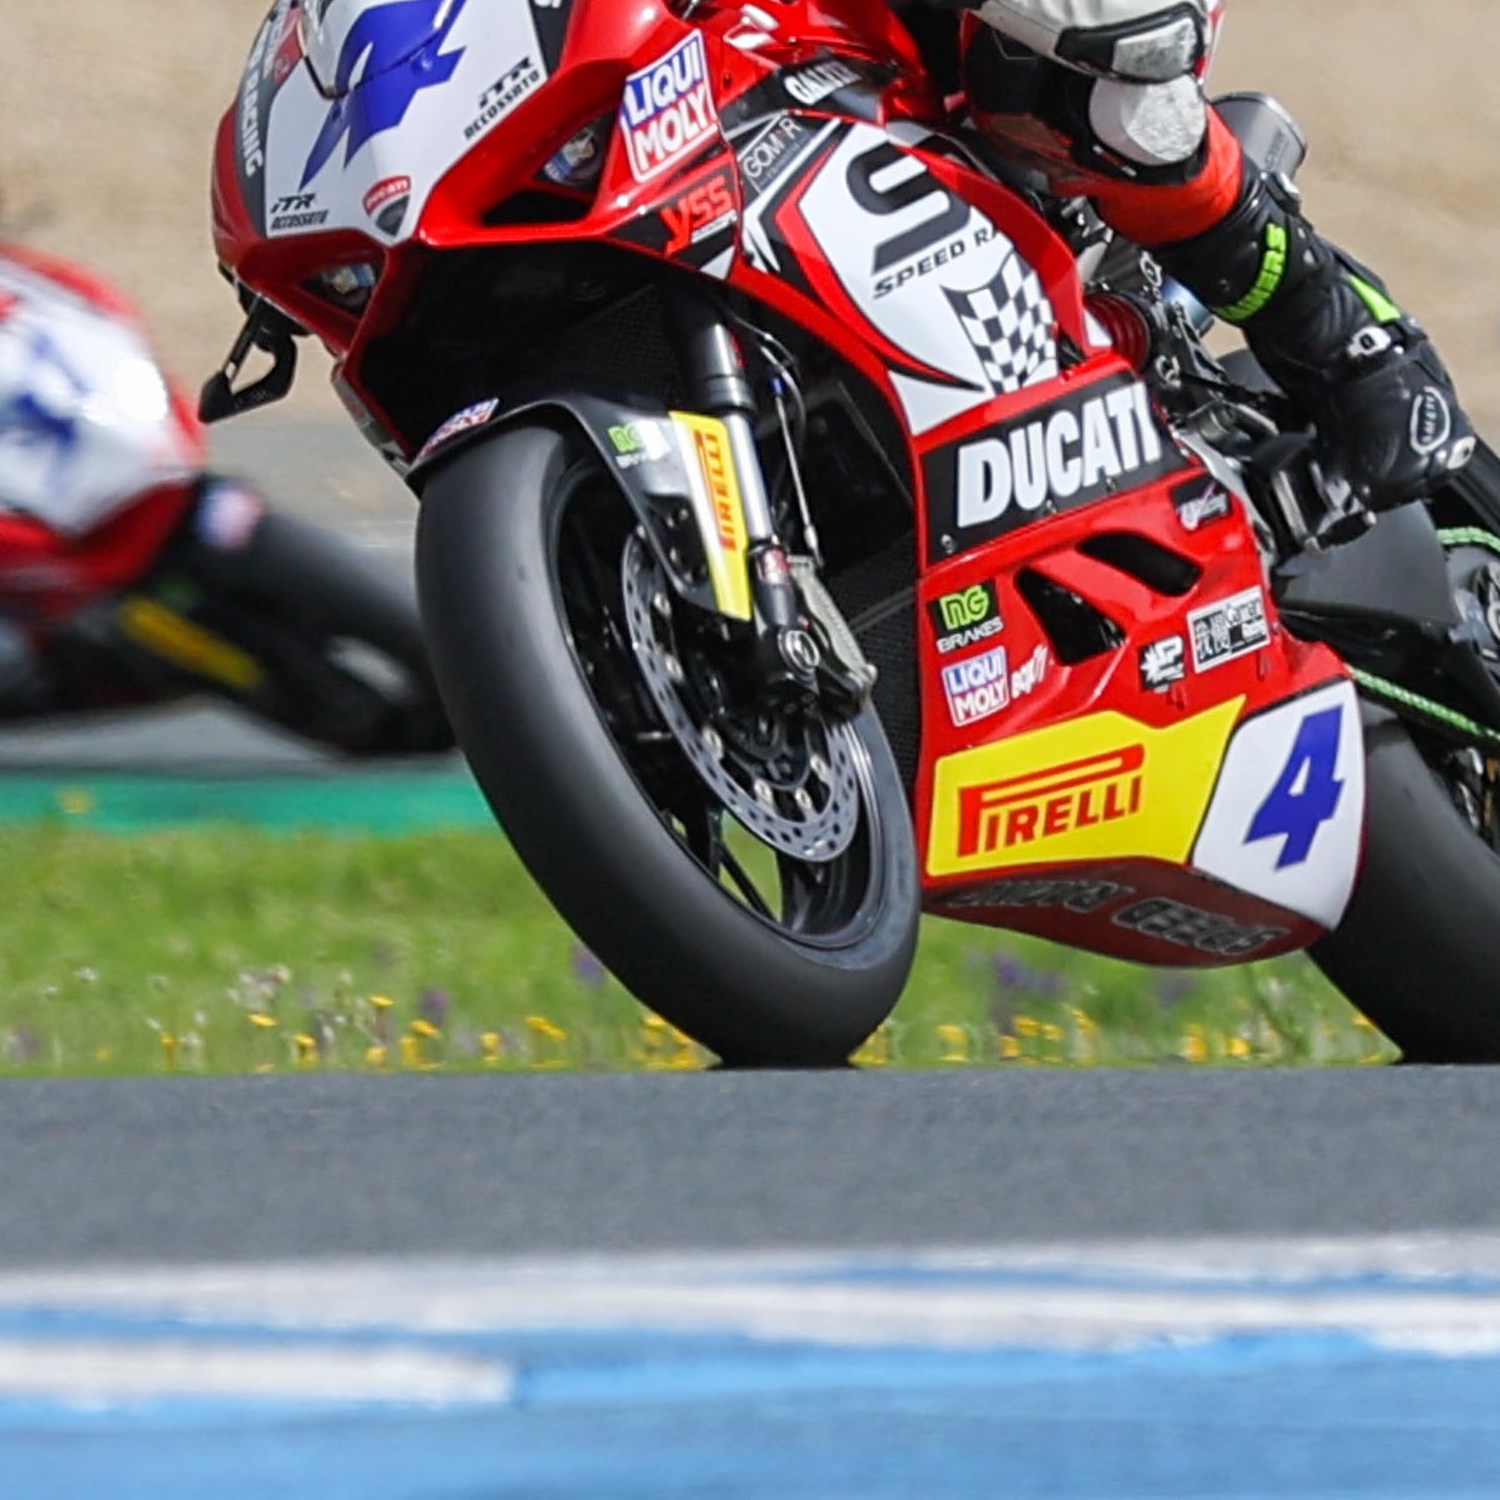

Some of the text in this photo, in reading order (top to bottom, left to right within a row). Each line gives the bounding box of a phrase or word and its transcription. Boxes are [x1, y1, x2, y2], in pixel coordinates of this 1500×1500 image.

[624, 38, 704, 127] LIQUI
[634, 82, 711, 173] MOLY
[873, 239, 966, 300] SPEED
[693, 429, 738, 552] PIRELLI
[957, 381, 1162, 528] DUCATI
[936, 615, 1004, 654] BRAKES
[947, 651, 1005, 696] LIQUI
[953, 679, 1006, 720] MOLY
[956, 743, 1146, 858] PIRELLI
[1243, 704, 1345, 871] 4
